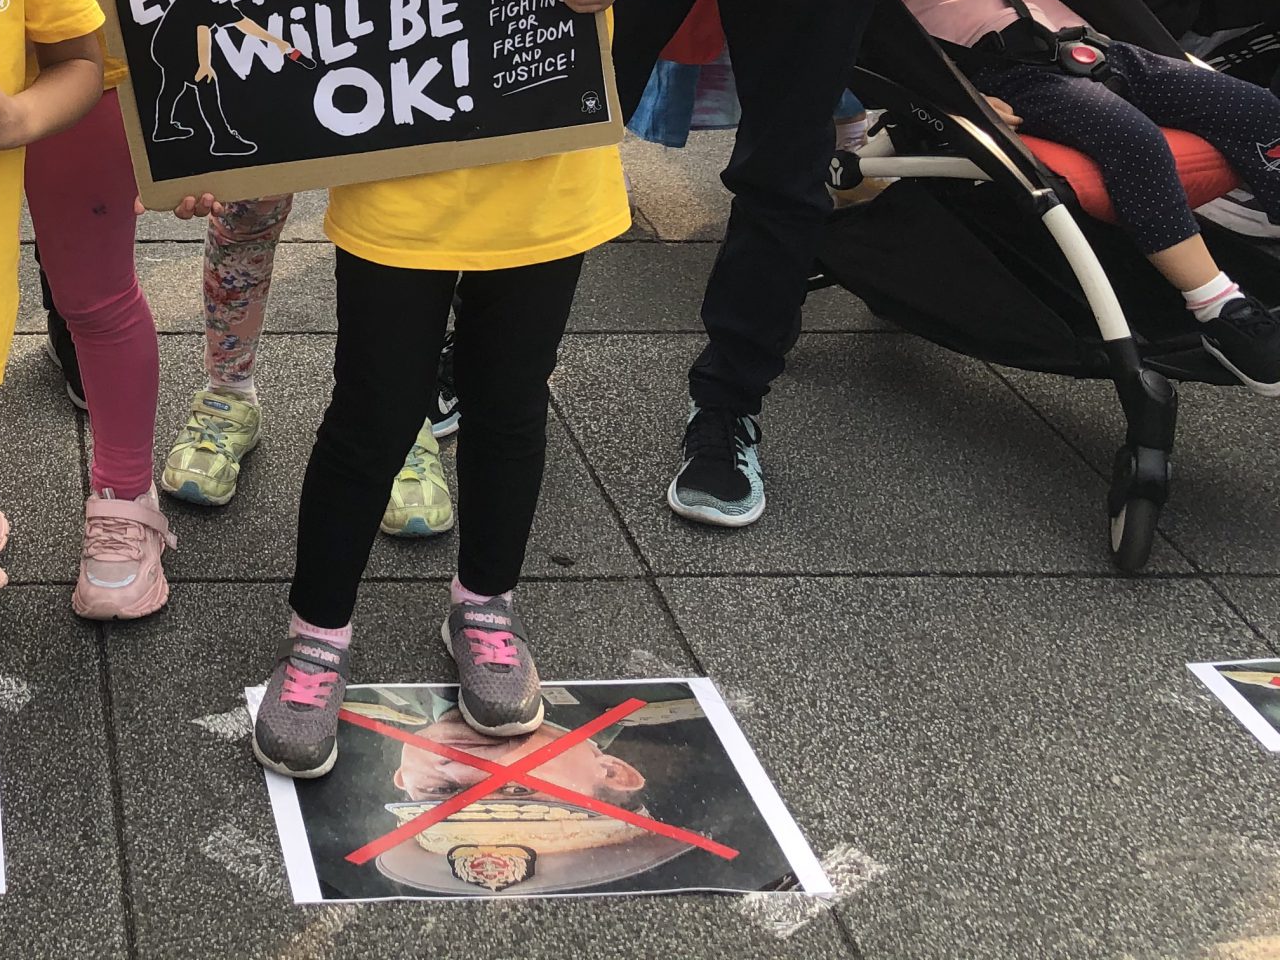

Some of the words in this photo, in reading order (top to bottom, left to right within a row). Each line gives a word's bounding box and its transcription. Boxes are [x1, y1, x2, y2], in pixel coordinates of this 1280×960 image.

[493, 19, 575, 59] FREEDOM
[508, 14, 539, 35] FOR
[493, 48, 575, 89] JUSTICE!
[512, 48, 542, 65] AND
[313, 39, 475, 137] OK!
